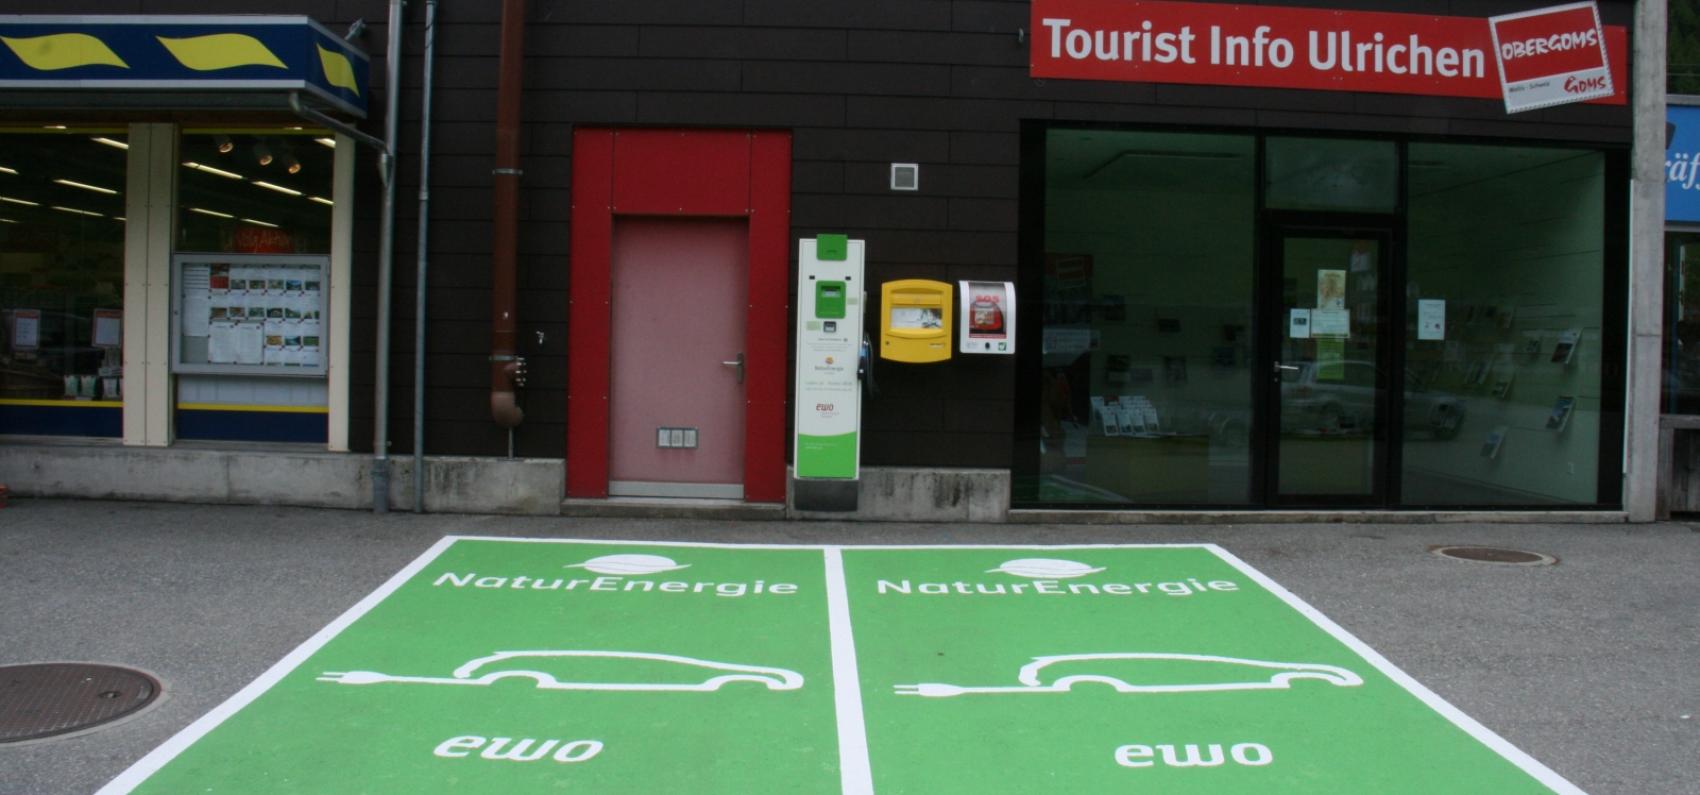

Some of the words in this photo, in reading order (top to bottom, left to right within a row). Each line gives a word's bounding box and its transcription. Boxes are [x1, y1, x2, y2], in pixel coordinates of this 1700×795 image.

[1042, 17, 1196, 64] Tourist
[1210, 25, 1294, 69] Info
[1308, 30, 1485, 78] Ulrichen
[1501, 28, 1599, 61] OBERGOMS
[1563, 75, 1607, 94] GOMS
[816, 403, 834, 411] ewo
[433, 572, 799, 597] NaturEnergie
[877, 578, 1240, 597] NaturEnergie
[433, 735, 604, 764] ewo
[1114, 743, 1274, 768] ewo
